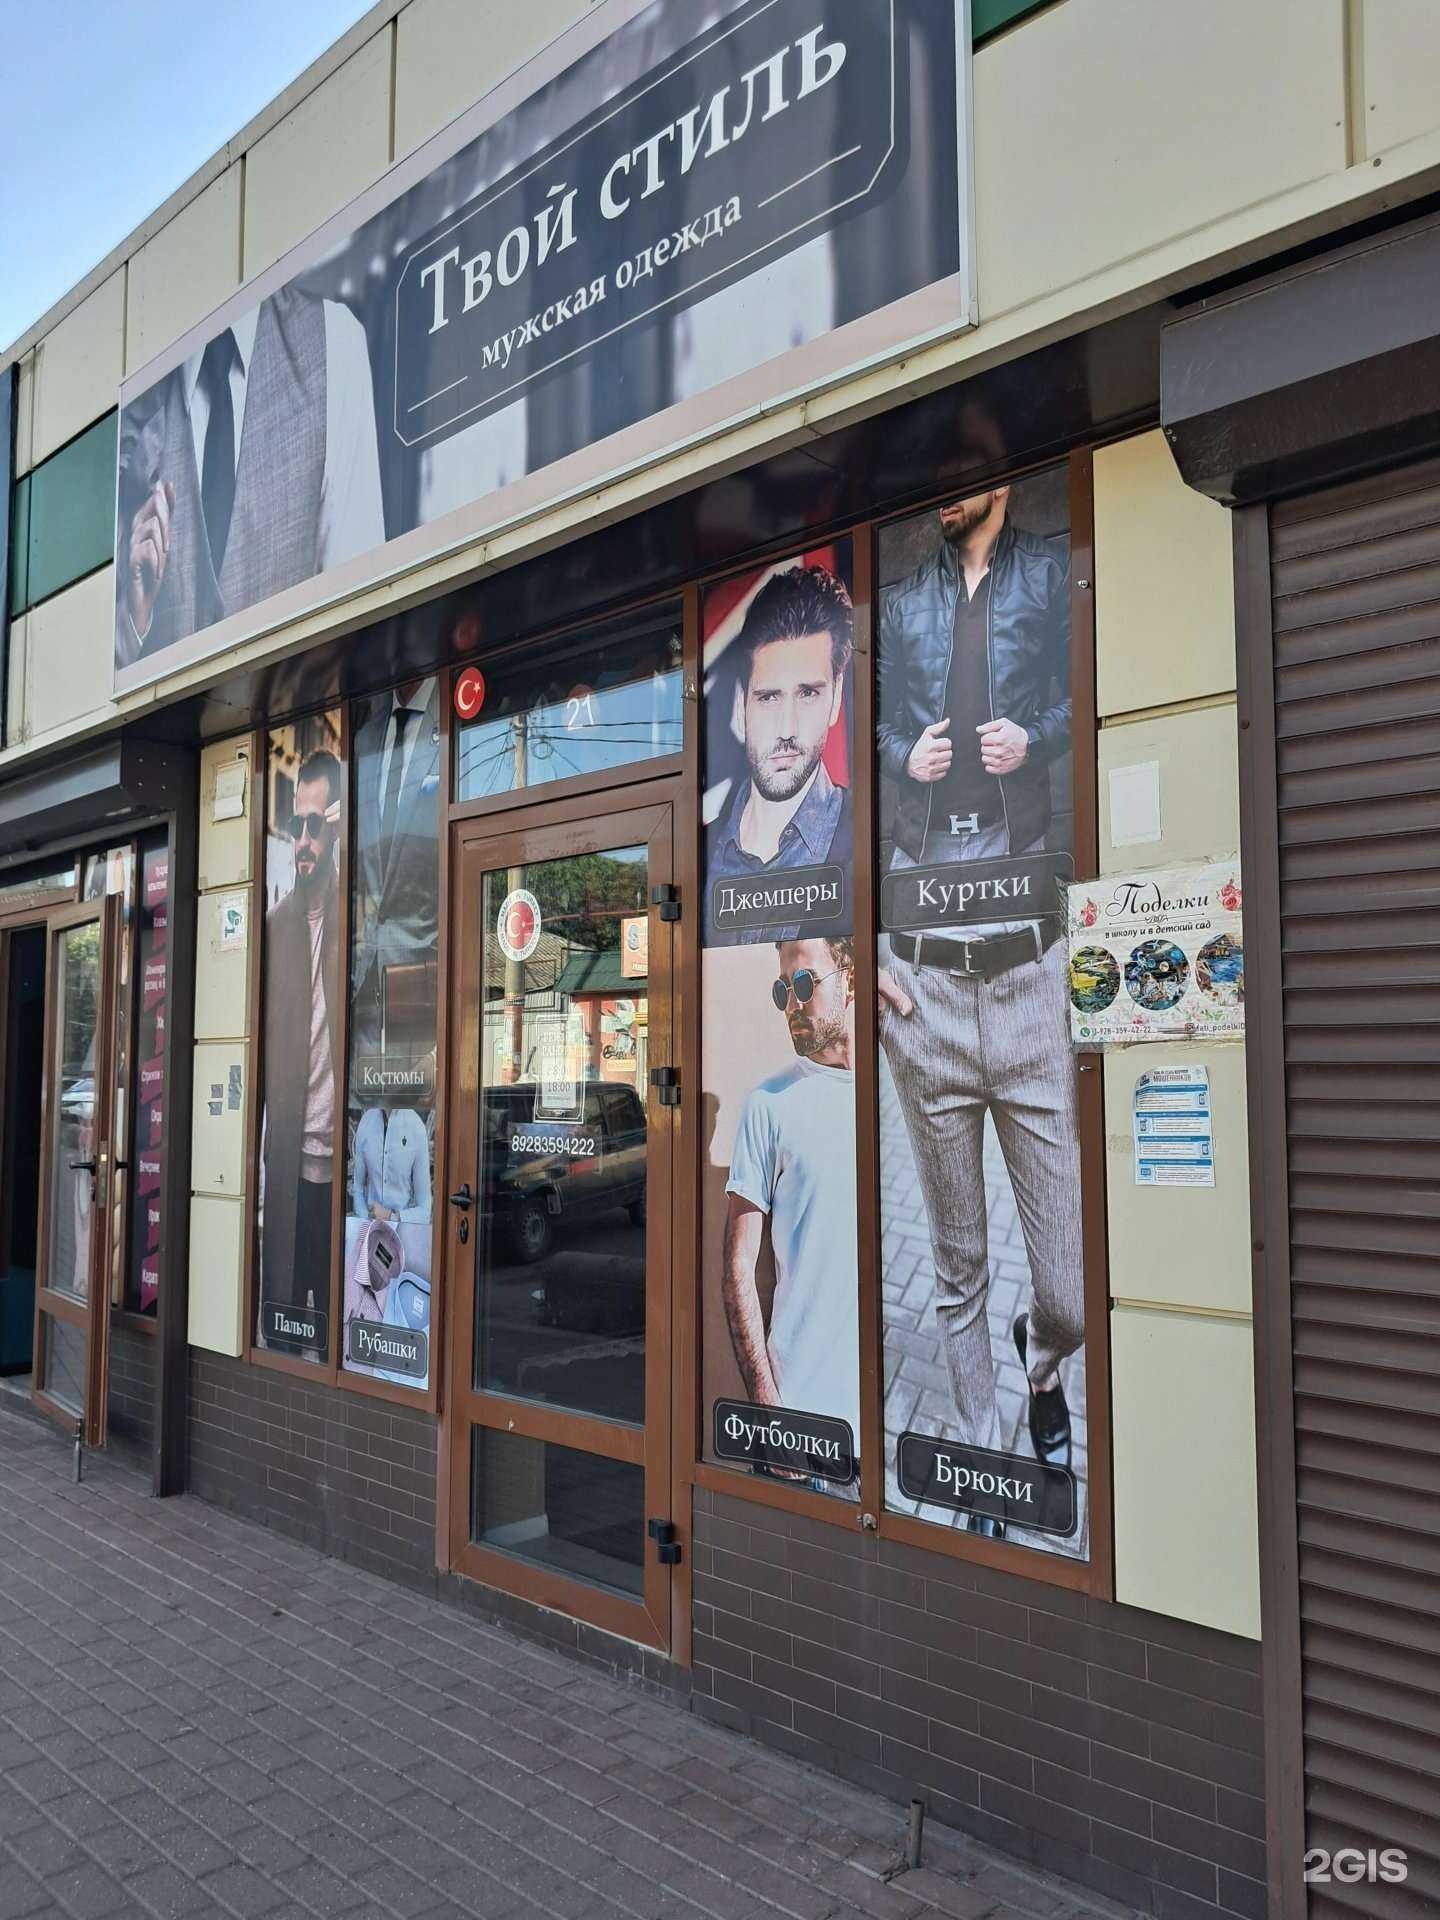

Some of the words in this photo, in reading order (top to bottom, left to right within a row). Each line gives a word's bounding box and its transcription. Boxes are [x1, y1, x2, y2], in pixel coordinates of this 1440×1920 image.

[421, 182, 577, 334] Твой
[600, 24, 847, 220] стиль
[481, 275, 607, 369] мужская
[615, 196, 742, 289] одежда
[566, 694, 595, 731] 21
[718, 879, 838, 918] Джемперы
[917, 874, 1031, 913] Куртки
[1105, 881, 1209, 917] Поделки
[1111, 927, 1138, 938] школу
[1140, 926, 1146, 935] и
[1148, 926, 1153, 934] в
[1155, 922, 1194, 934] детский
[1195, 920, 1212, 930] сад
[364, 1066, 424, 1085] Костюмы
[511, 1135, 595, 1156] 89283594222
[274, 1312, 315, 1338] Пальто
[358, 1329, 417, 1360] Рубашки
[724, 1413, 841, 1461] Футболки
[935, 1453, 1034, 1504] Брюки
